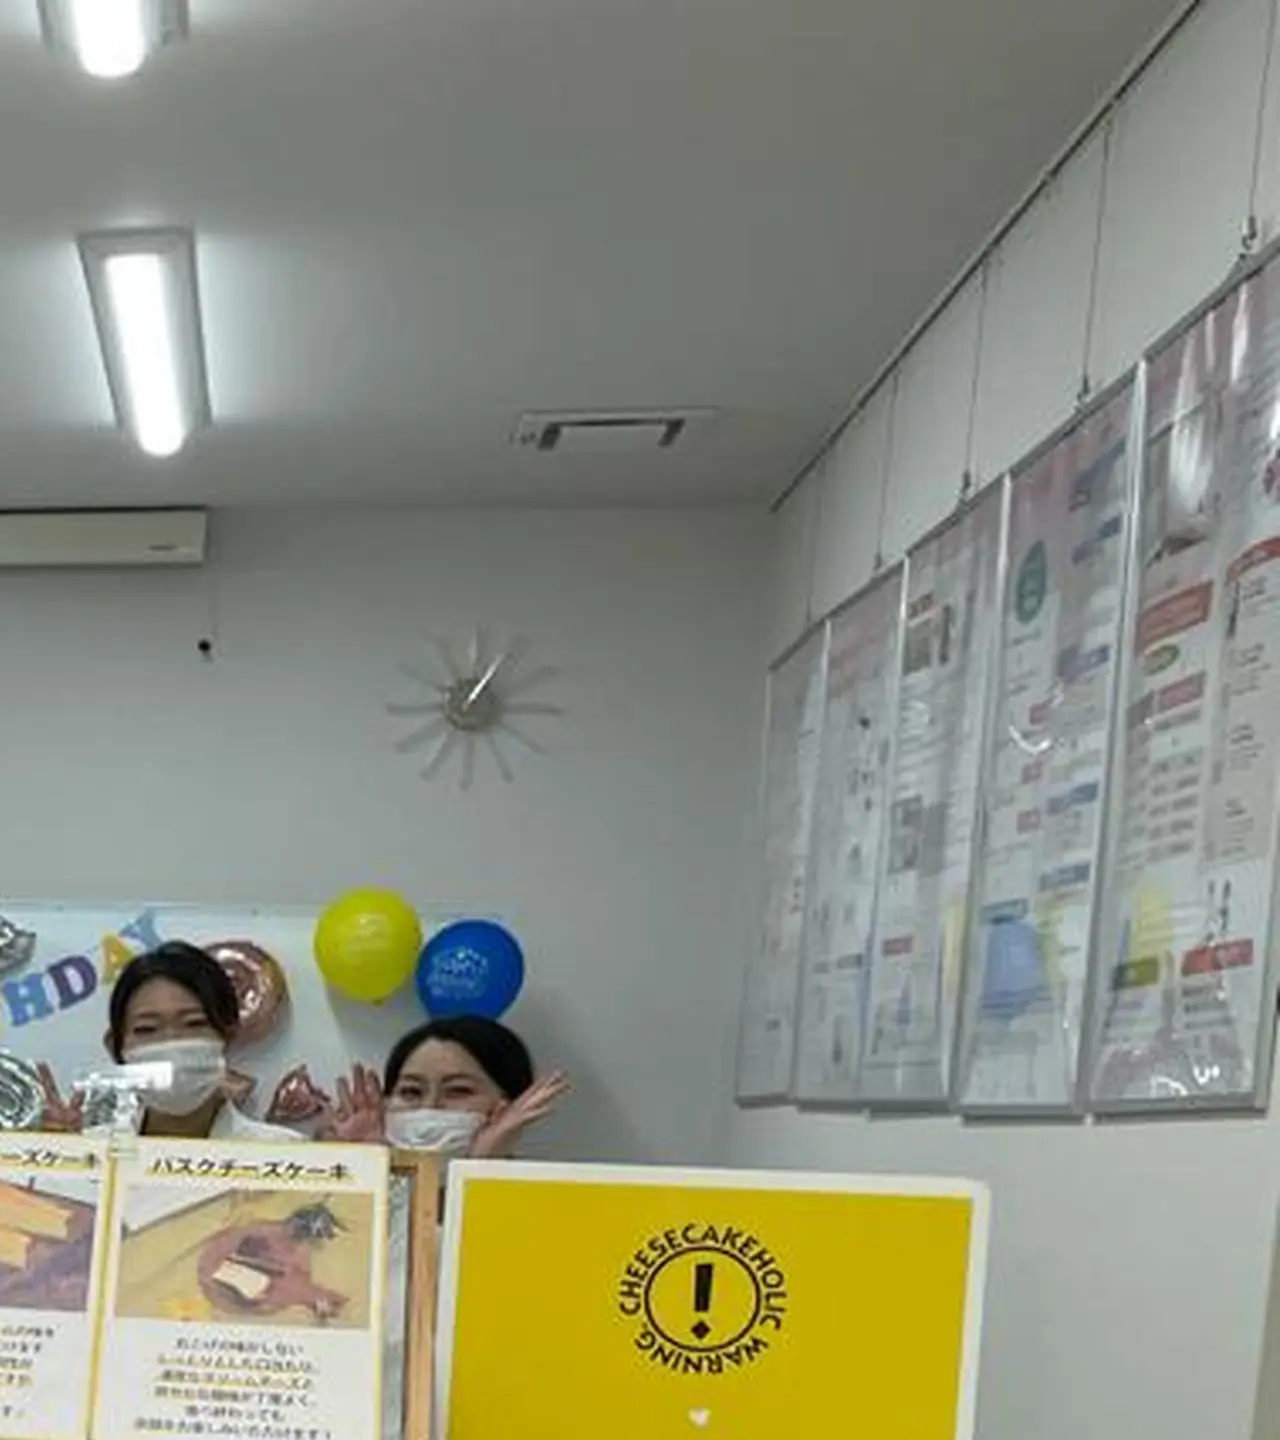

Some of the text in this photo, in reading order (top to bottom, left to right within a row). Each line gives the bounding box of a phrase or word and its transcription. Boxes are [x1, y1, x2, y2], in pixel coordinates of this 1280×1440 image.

[151, 1155, 351, 1181] バスクチーズケーキ
[619, 1222, 787, 1332] CHEESECAKEHOLIC
[633, 1324, 770, 1375] WARNING
